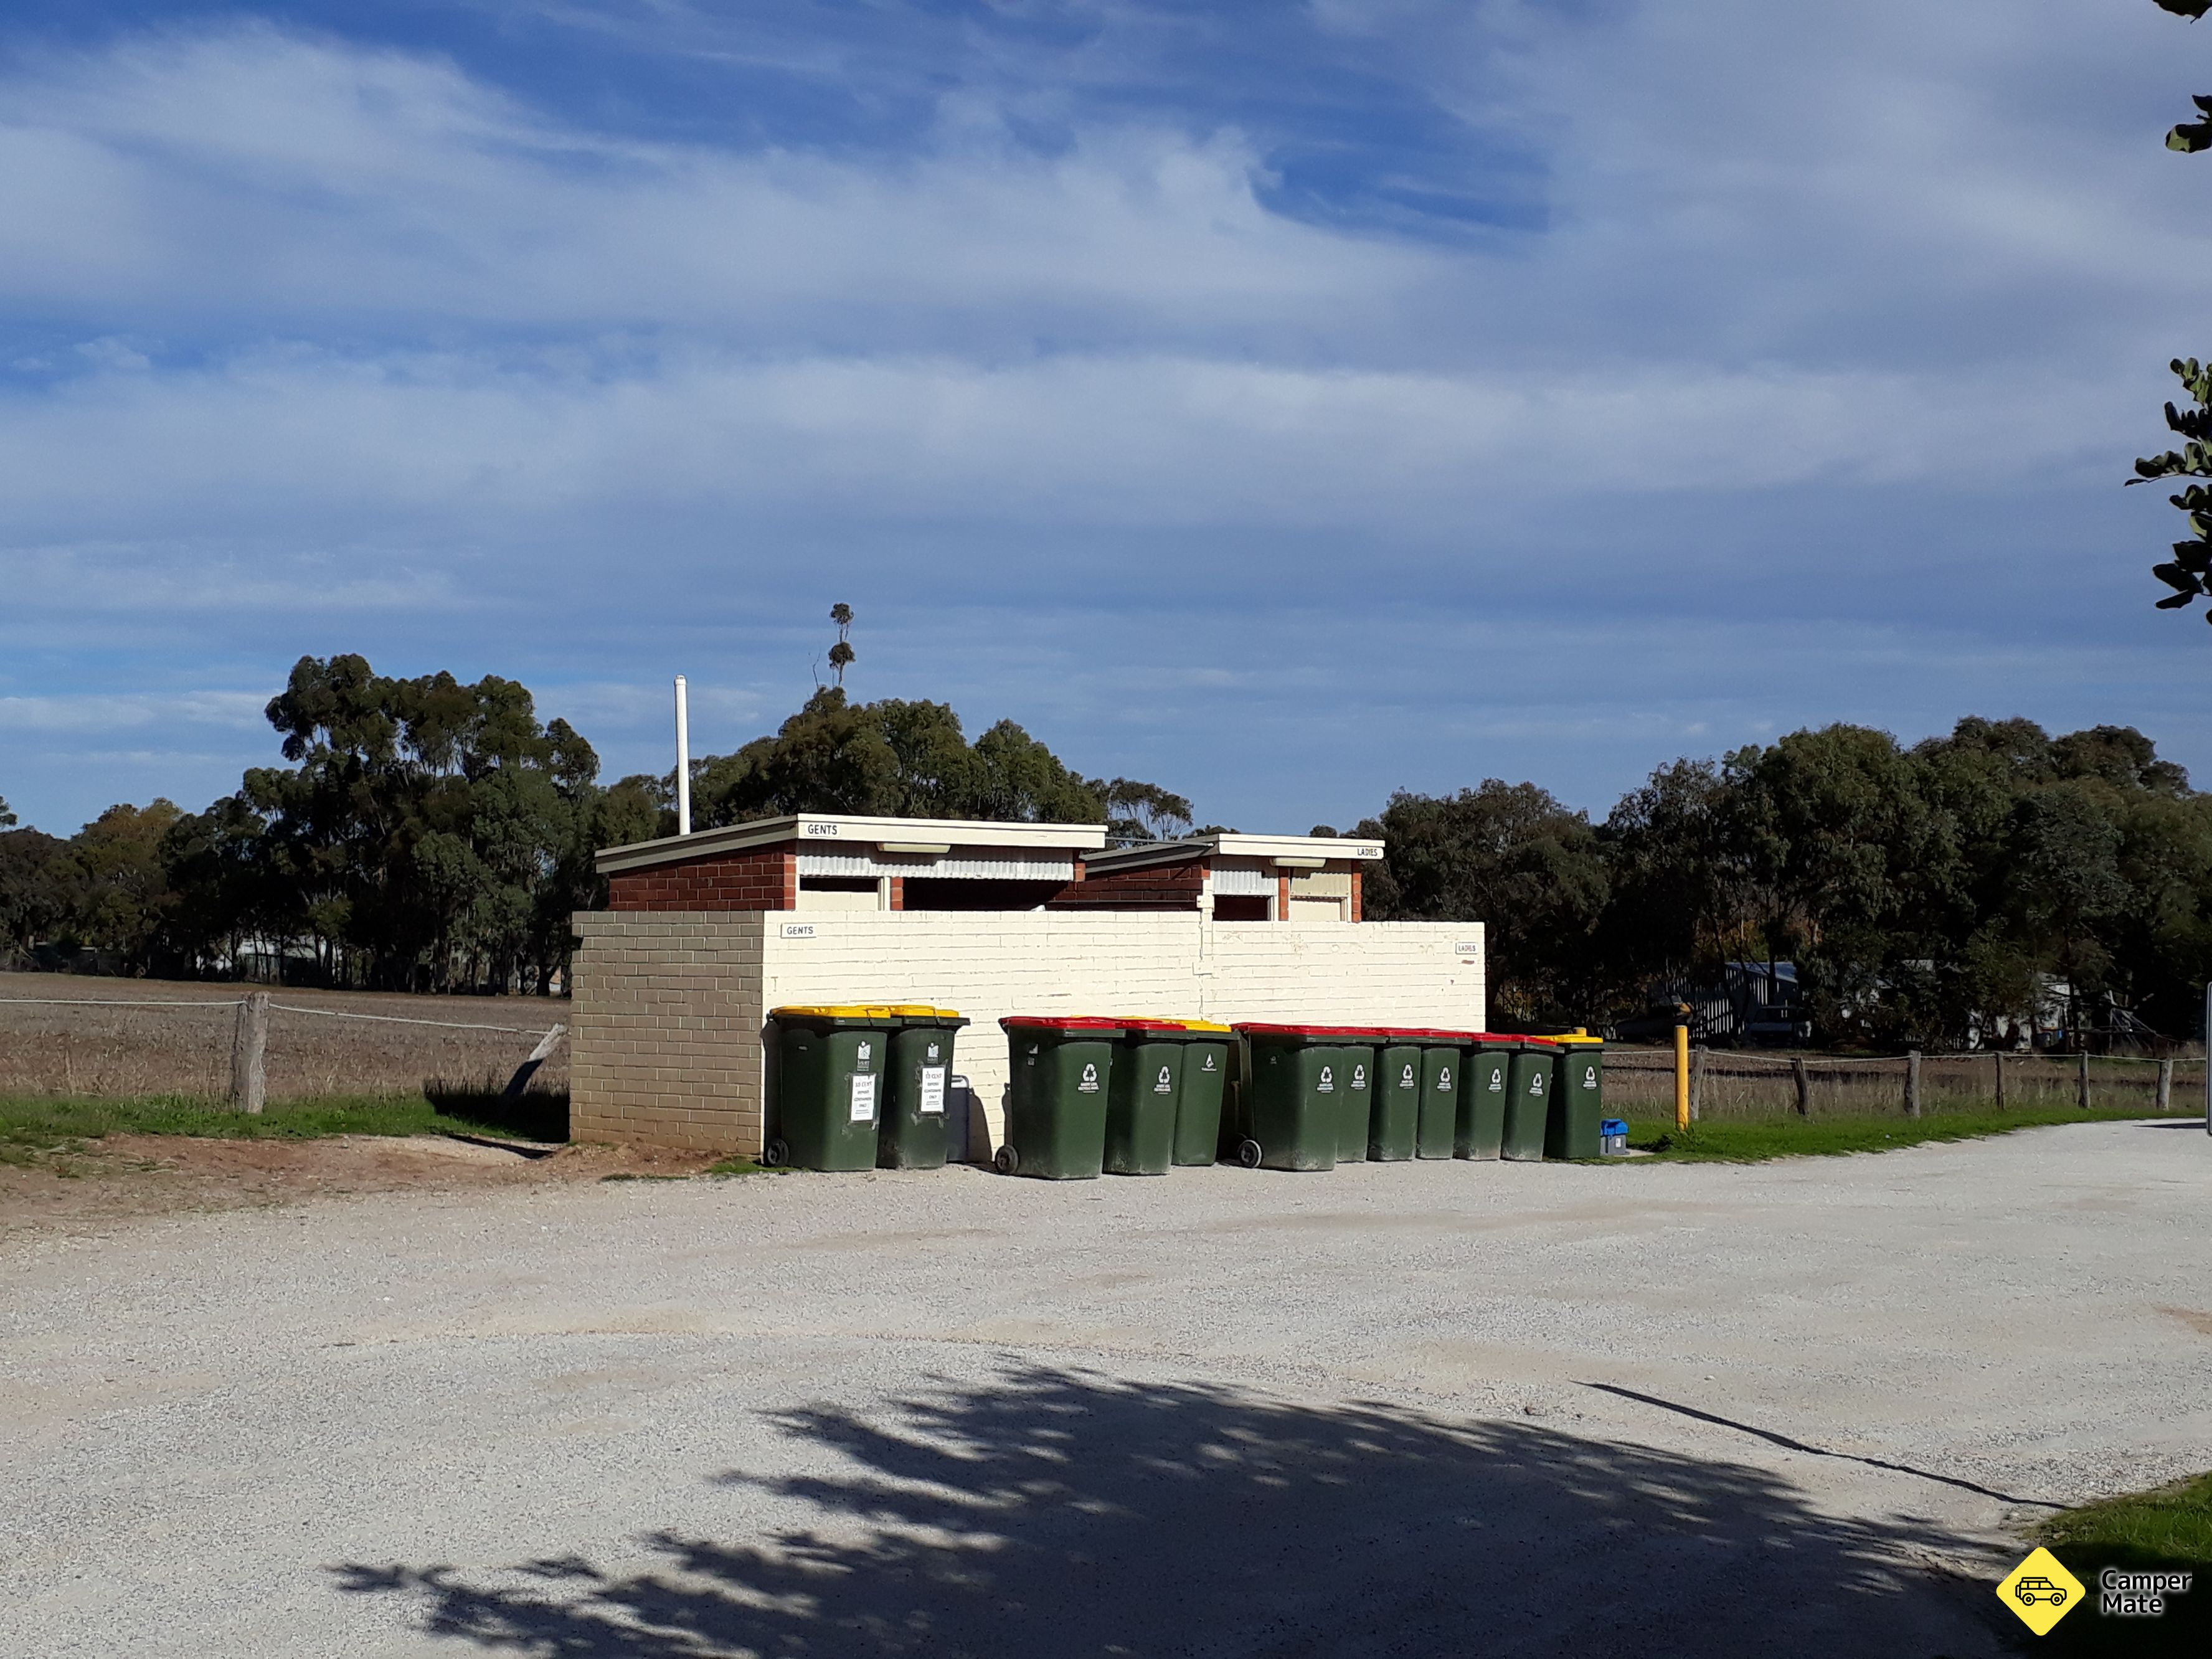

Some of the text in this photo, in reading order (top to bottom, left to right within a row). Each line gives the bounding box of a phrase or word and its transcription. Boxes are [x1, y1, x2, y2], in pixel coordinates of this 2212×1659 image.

[808, 824, 838, 835] GENTS
[1357, 848, 1378, 856] LADIES
[787, 926, 813, 935] GENTS
